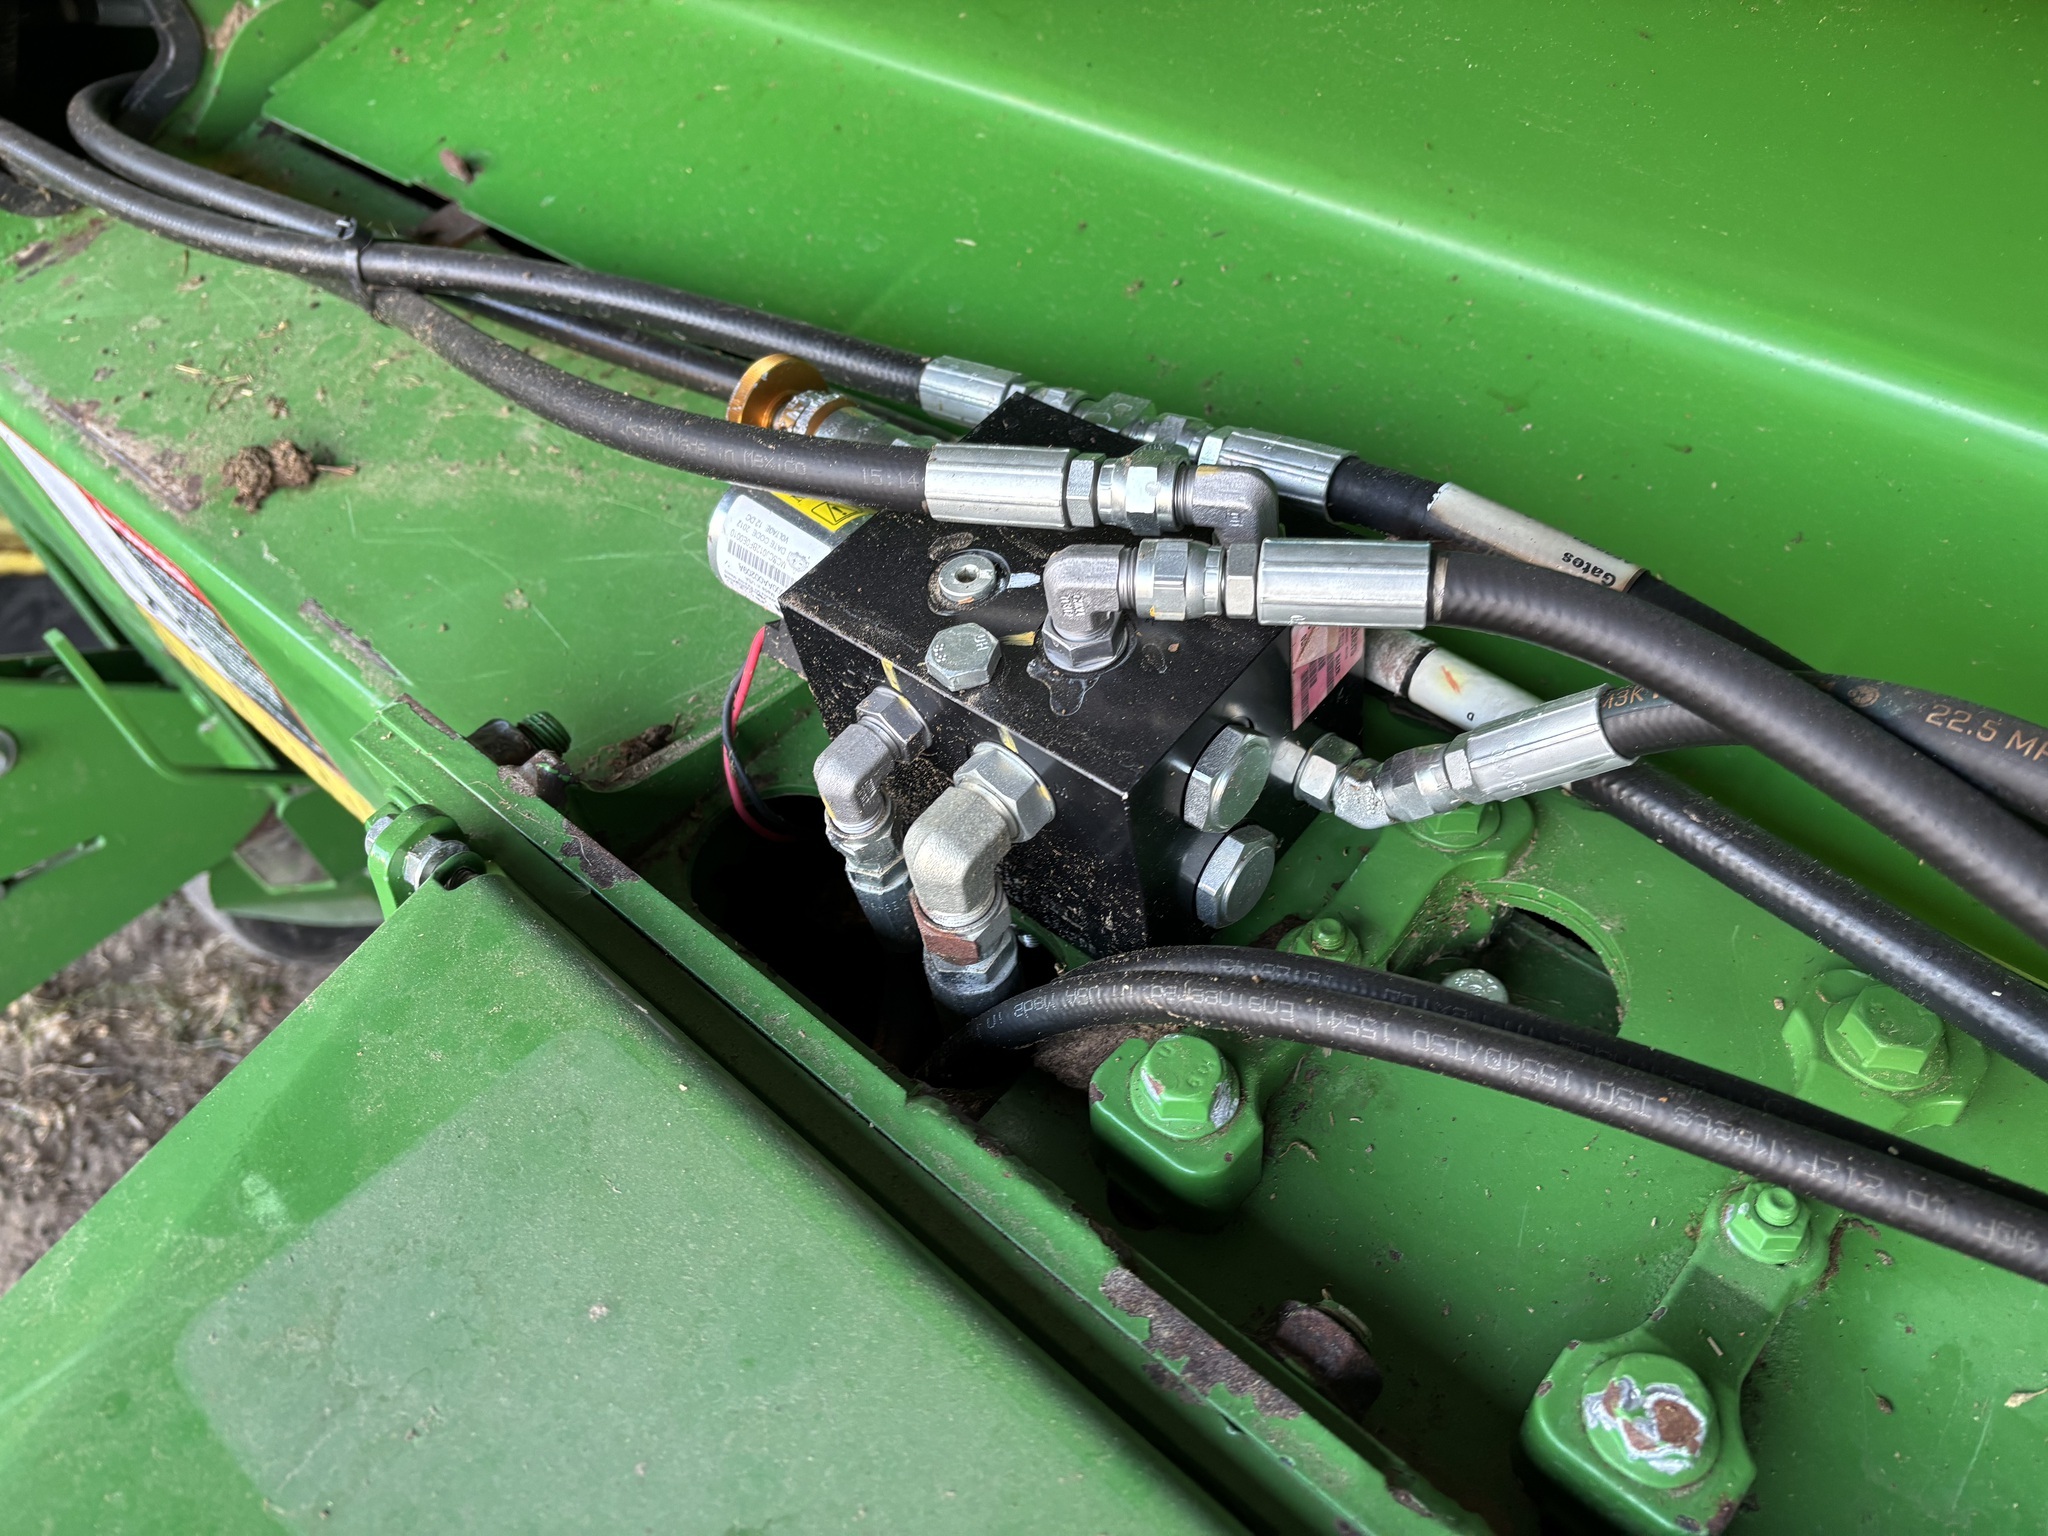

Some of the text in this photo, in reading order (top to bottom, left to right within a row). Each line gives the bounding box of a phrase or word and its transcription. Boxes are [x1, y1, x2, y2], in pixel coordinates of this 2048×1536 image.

[743, 448, 807, 476] Mexico
[1562, 551, 1617, 588] Gates
[1925, 704, 1999, 743] 22.5
